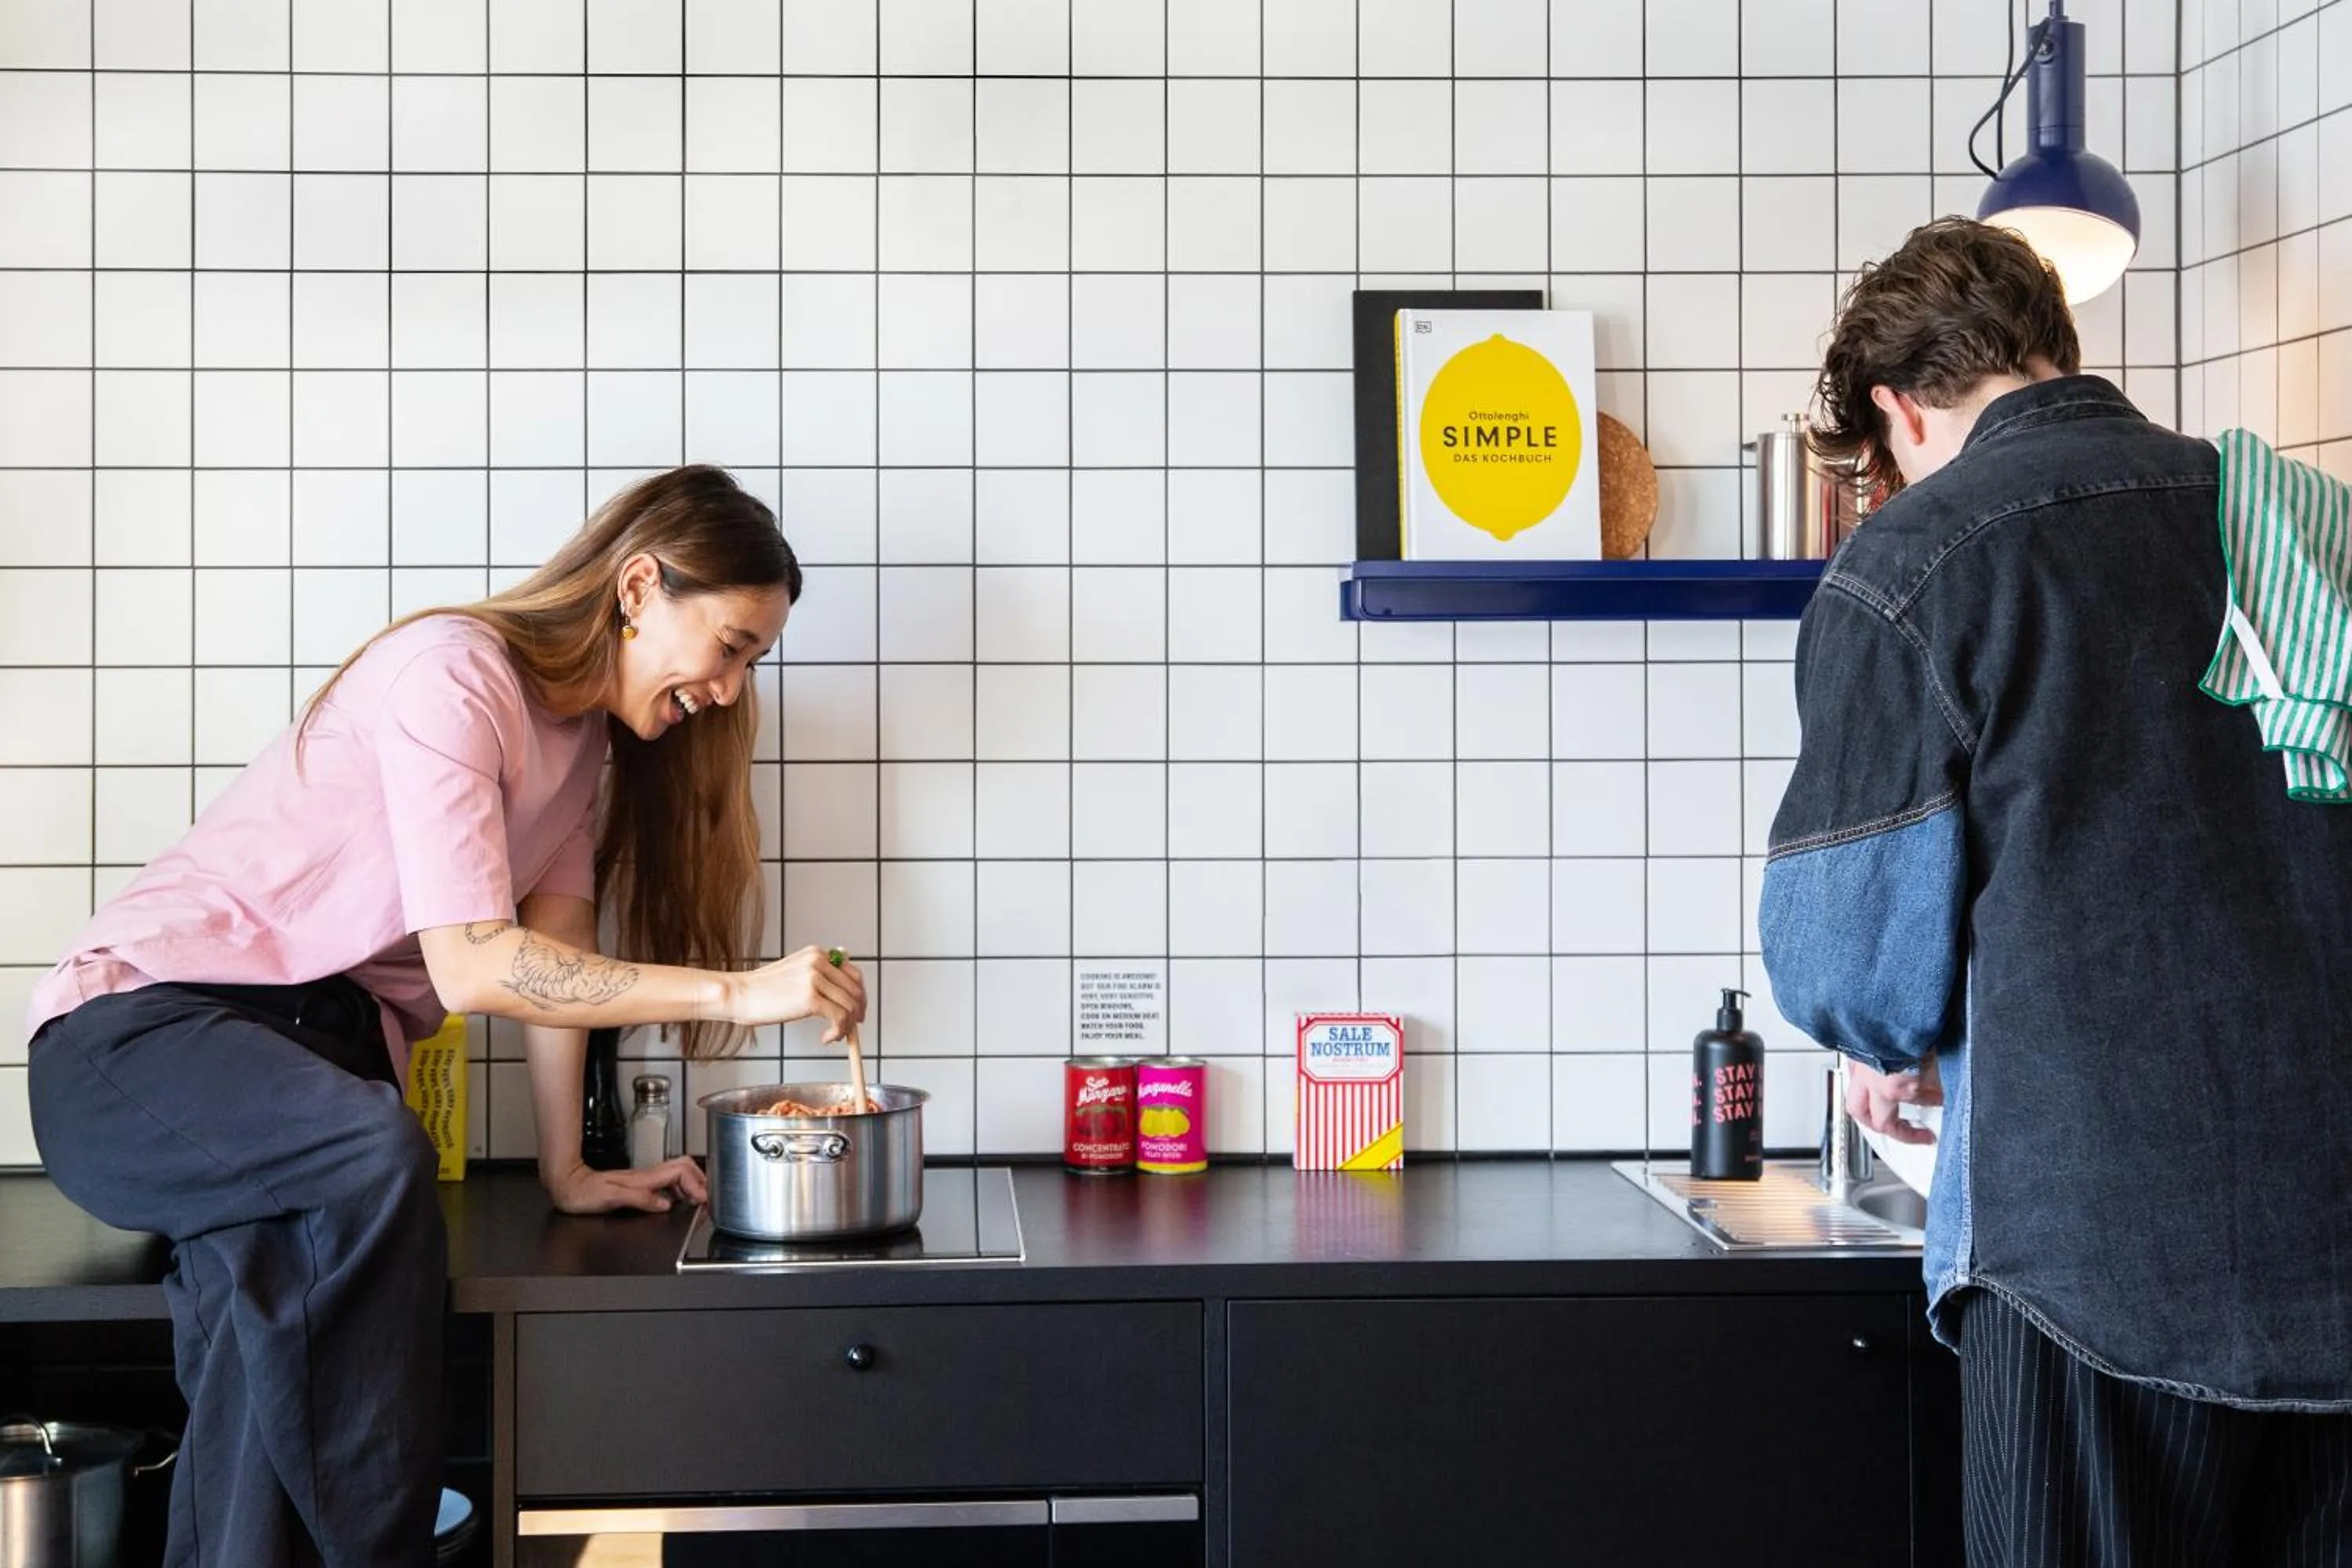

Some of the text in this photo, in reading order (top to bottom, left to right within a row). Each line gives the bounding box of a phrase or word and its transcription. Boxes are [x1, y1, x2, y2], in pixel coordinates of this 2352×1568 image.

[1468, 411, 1529, 422] Ottolenghi
[1443, 426, 1557, 448] SIMPLE
[1454, 454, 1552, 463] DAS KOCHBUCH
[1329, 1027, 1372, 1041] SALE
[1310, 1041, 1391, 1057] NOSTRUM
[1714, 1063, 1755, 1086] STAY
[1713, 1082, 1755, 1104] STAY
[1712, 1101, 1755, 1123] STAY
[1073, 1142, 1130, 1152] CONCENTRATO
[1141, 1142, 1187, 1152] POMODORI
